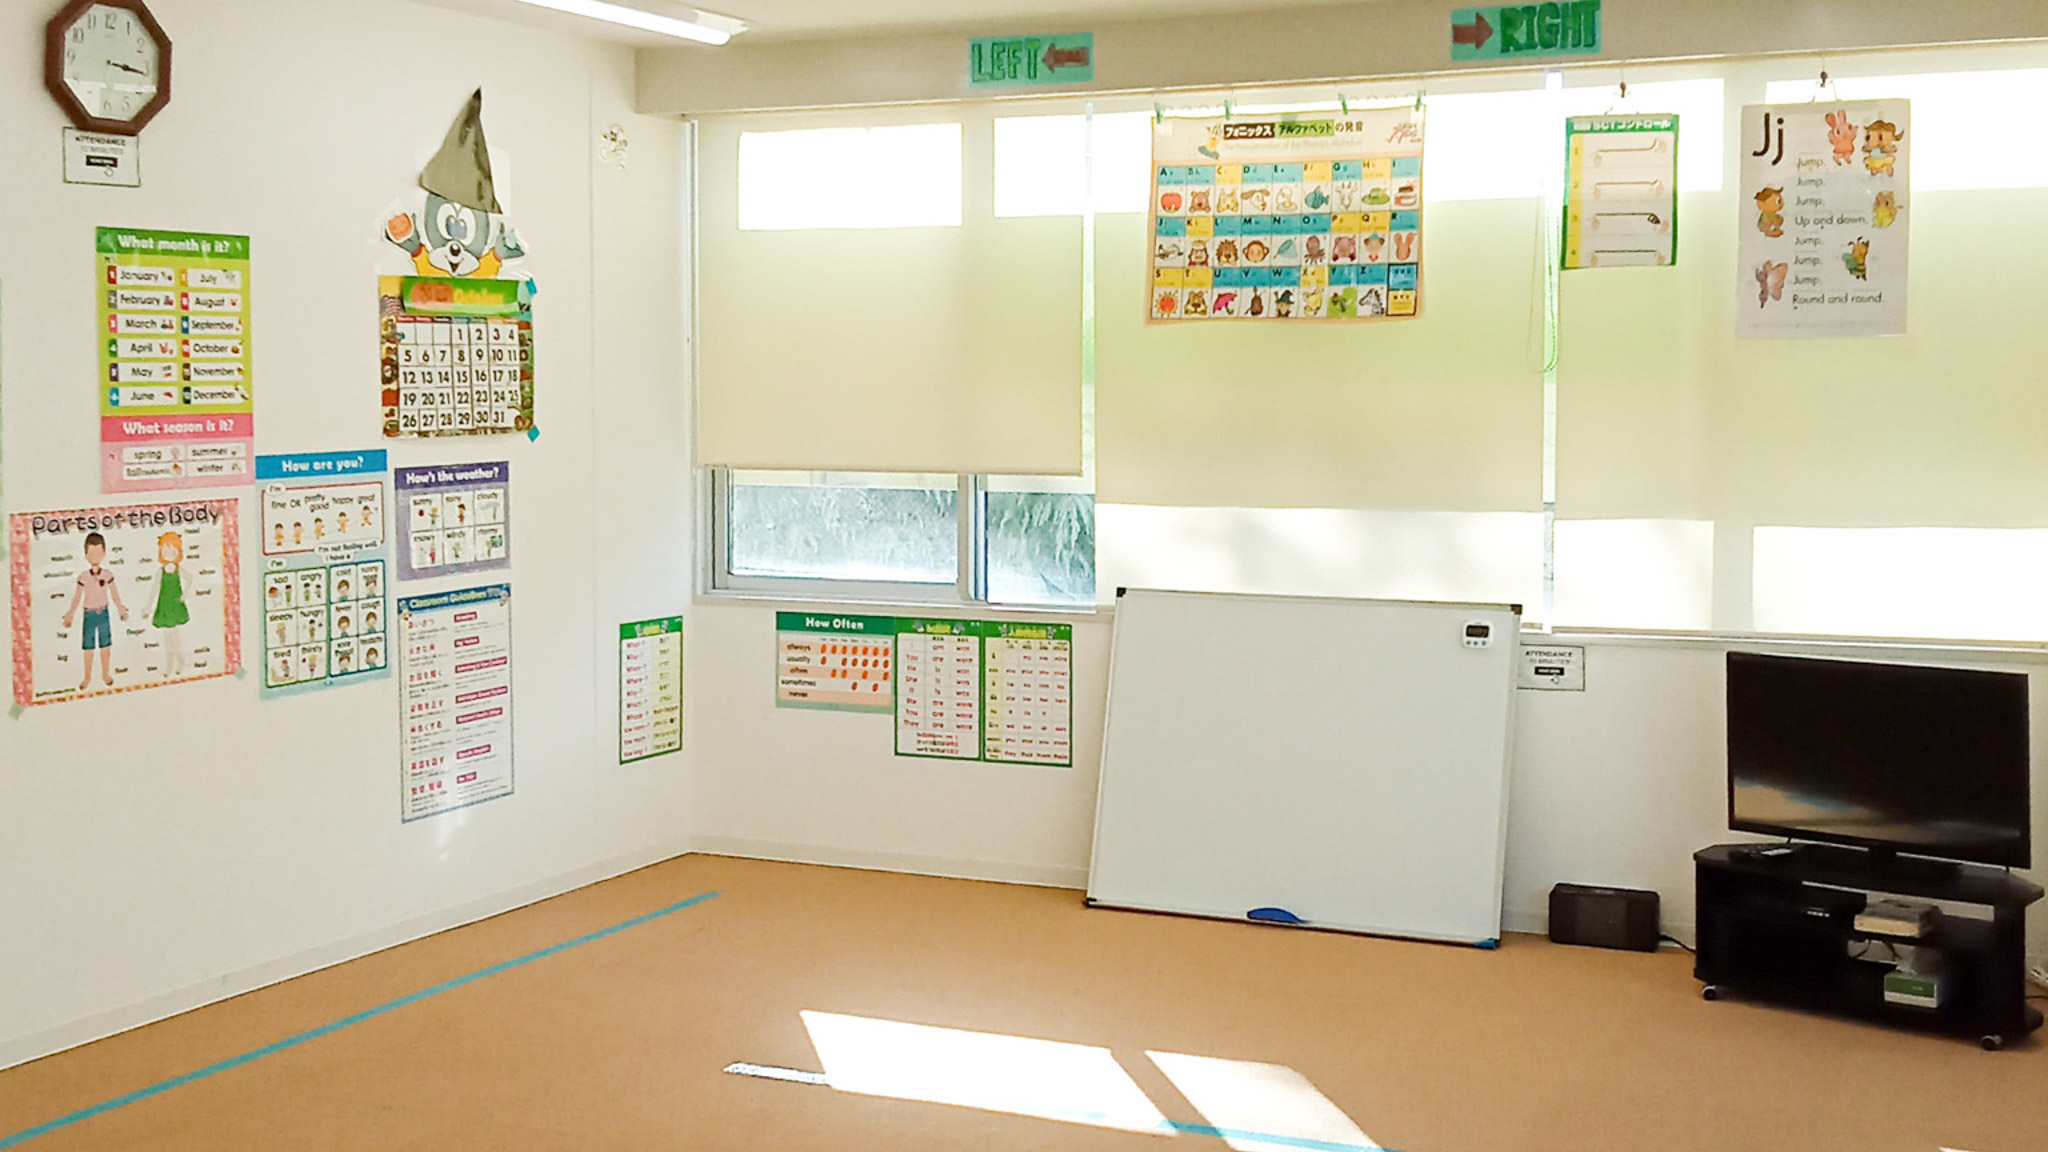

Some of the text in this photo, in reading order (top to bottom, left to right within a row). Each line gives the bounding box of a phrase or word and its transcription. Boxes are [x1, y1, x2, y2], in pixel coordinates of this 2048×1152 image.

[87, 14, 97, 29] 11
[105, 13, 117, 30] 12
[1500, 0, 1600, 53] RIGHT
[126, 21, 130, 35] 1
[73, 27, 84, 43] 10
[137, 38, 145, 53] 2
[972, 38, 1041, 82] LEFT
[1752, 112, 1784, 166] Jj
[1795, 216, 1810, 227] Up
[1813, 216, 1833, 224] and
[117, 235, 230, 253] What month is it?
[121, 271, 158, 281] January
[201, 274, 217, 284] July
[120, 295, 160, 305] February
[195, 298, 224, 308] August
[1793, 294, 1848, 304] Round and
[126, 320, 156, 328] March
[192, 321, 234, 330] September
[458, 329, 514, 340] 1 2 3 4
[131, 344, 152, 353] April
[193, 344, 228, 353] October
[405, 349, 517, 362] 5 6 7 8 9 10 11
[131, 368, 152, 377] May
[193, 368, 234, 376] November
[403, 370, 517, 384] 12 13 14 15 16 17 18
[131, 392, 155, 400] June
[193, 391, 235, 399] December
[404, 390, 518, 405] 19 20 21 22 23 24 25
[402, 411, 505, 427] 26 27 28 29 30 31
[123, 420, 234, 434] What season is it?
[134, 452, 162, 460] spring
[192, 448, 227, 456] summer
[281, 456, 363, 472] How are you?
[437, 471, 454, 481] the
[455, 467, 499, 480] weather?
[310, 502, 329, 513] good
[32, 505, 221, 541] Parts of the Body
[274, 576, 288, 584] sad
[805, 618, 830, 628] How
